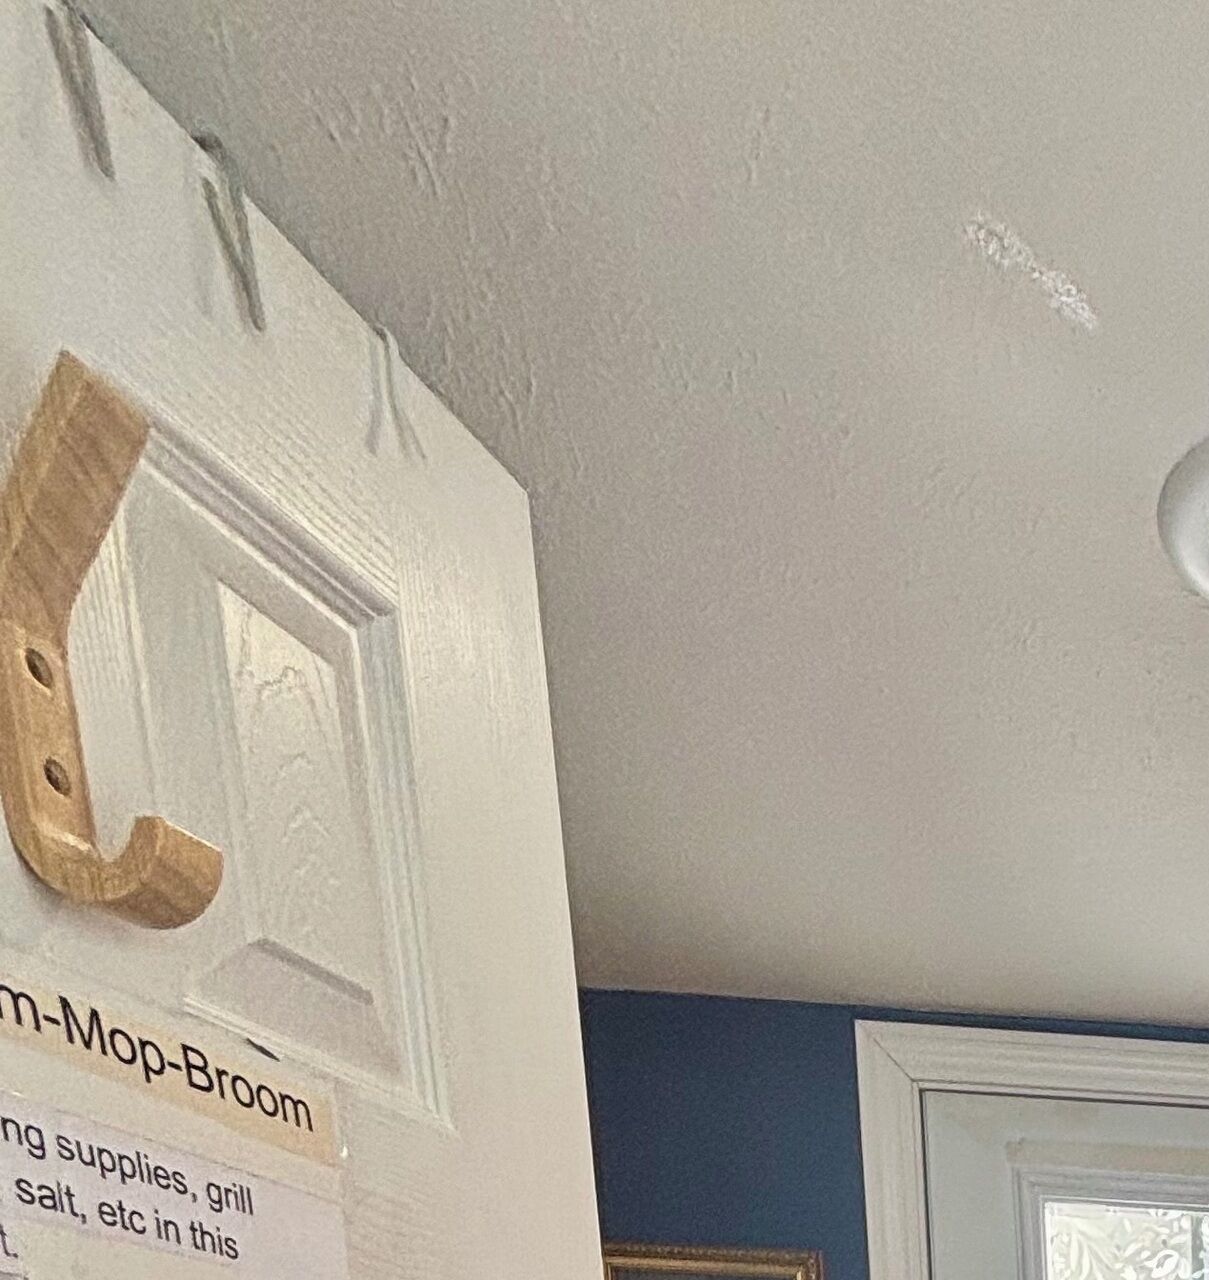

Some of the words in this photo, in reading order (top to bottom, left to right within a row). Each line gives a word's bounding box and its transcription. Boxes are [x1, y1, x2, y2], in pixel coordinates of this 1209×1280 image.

[56, 1134, 197, 1203] supplies,
[206, 1177, 254, 1215] grill
[15, 1177, 87, 1225] salt,
[98, 1200, 146, 1236] etc
[155, 1209, 182, 1245] in
[190, 1221, 240, 1260] this
